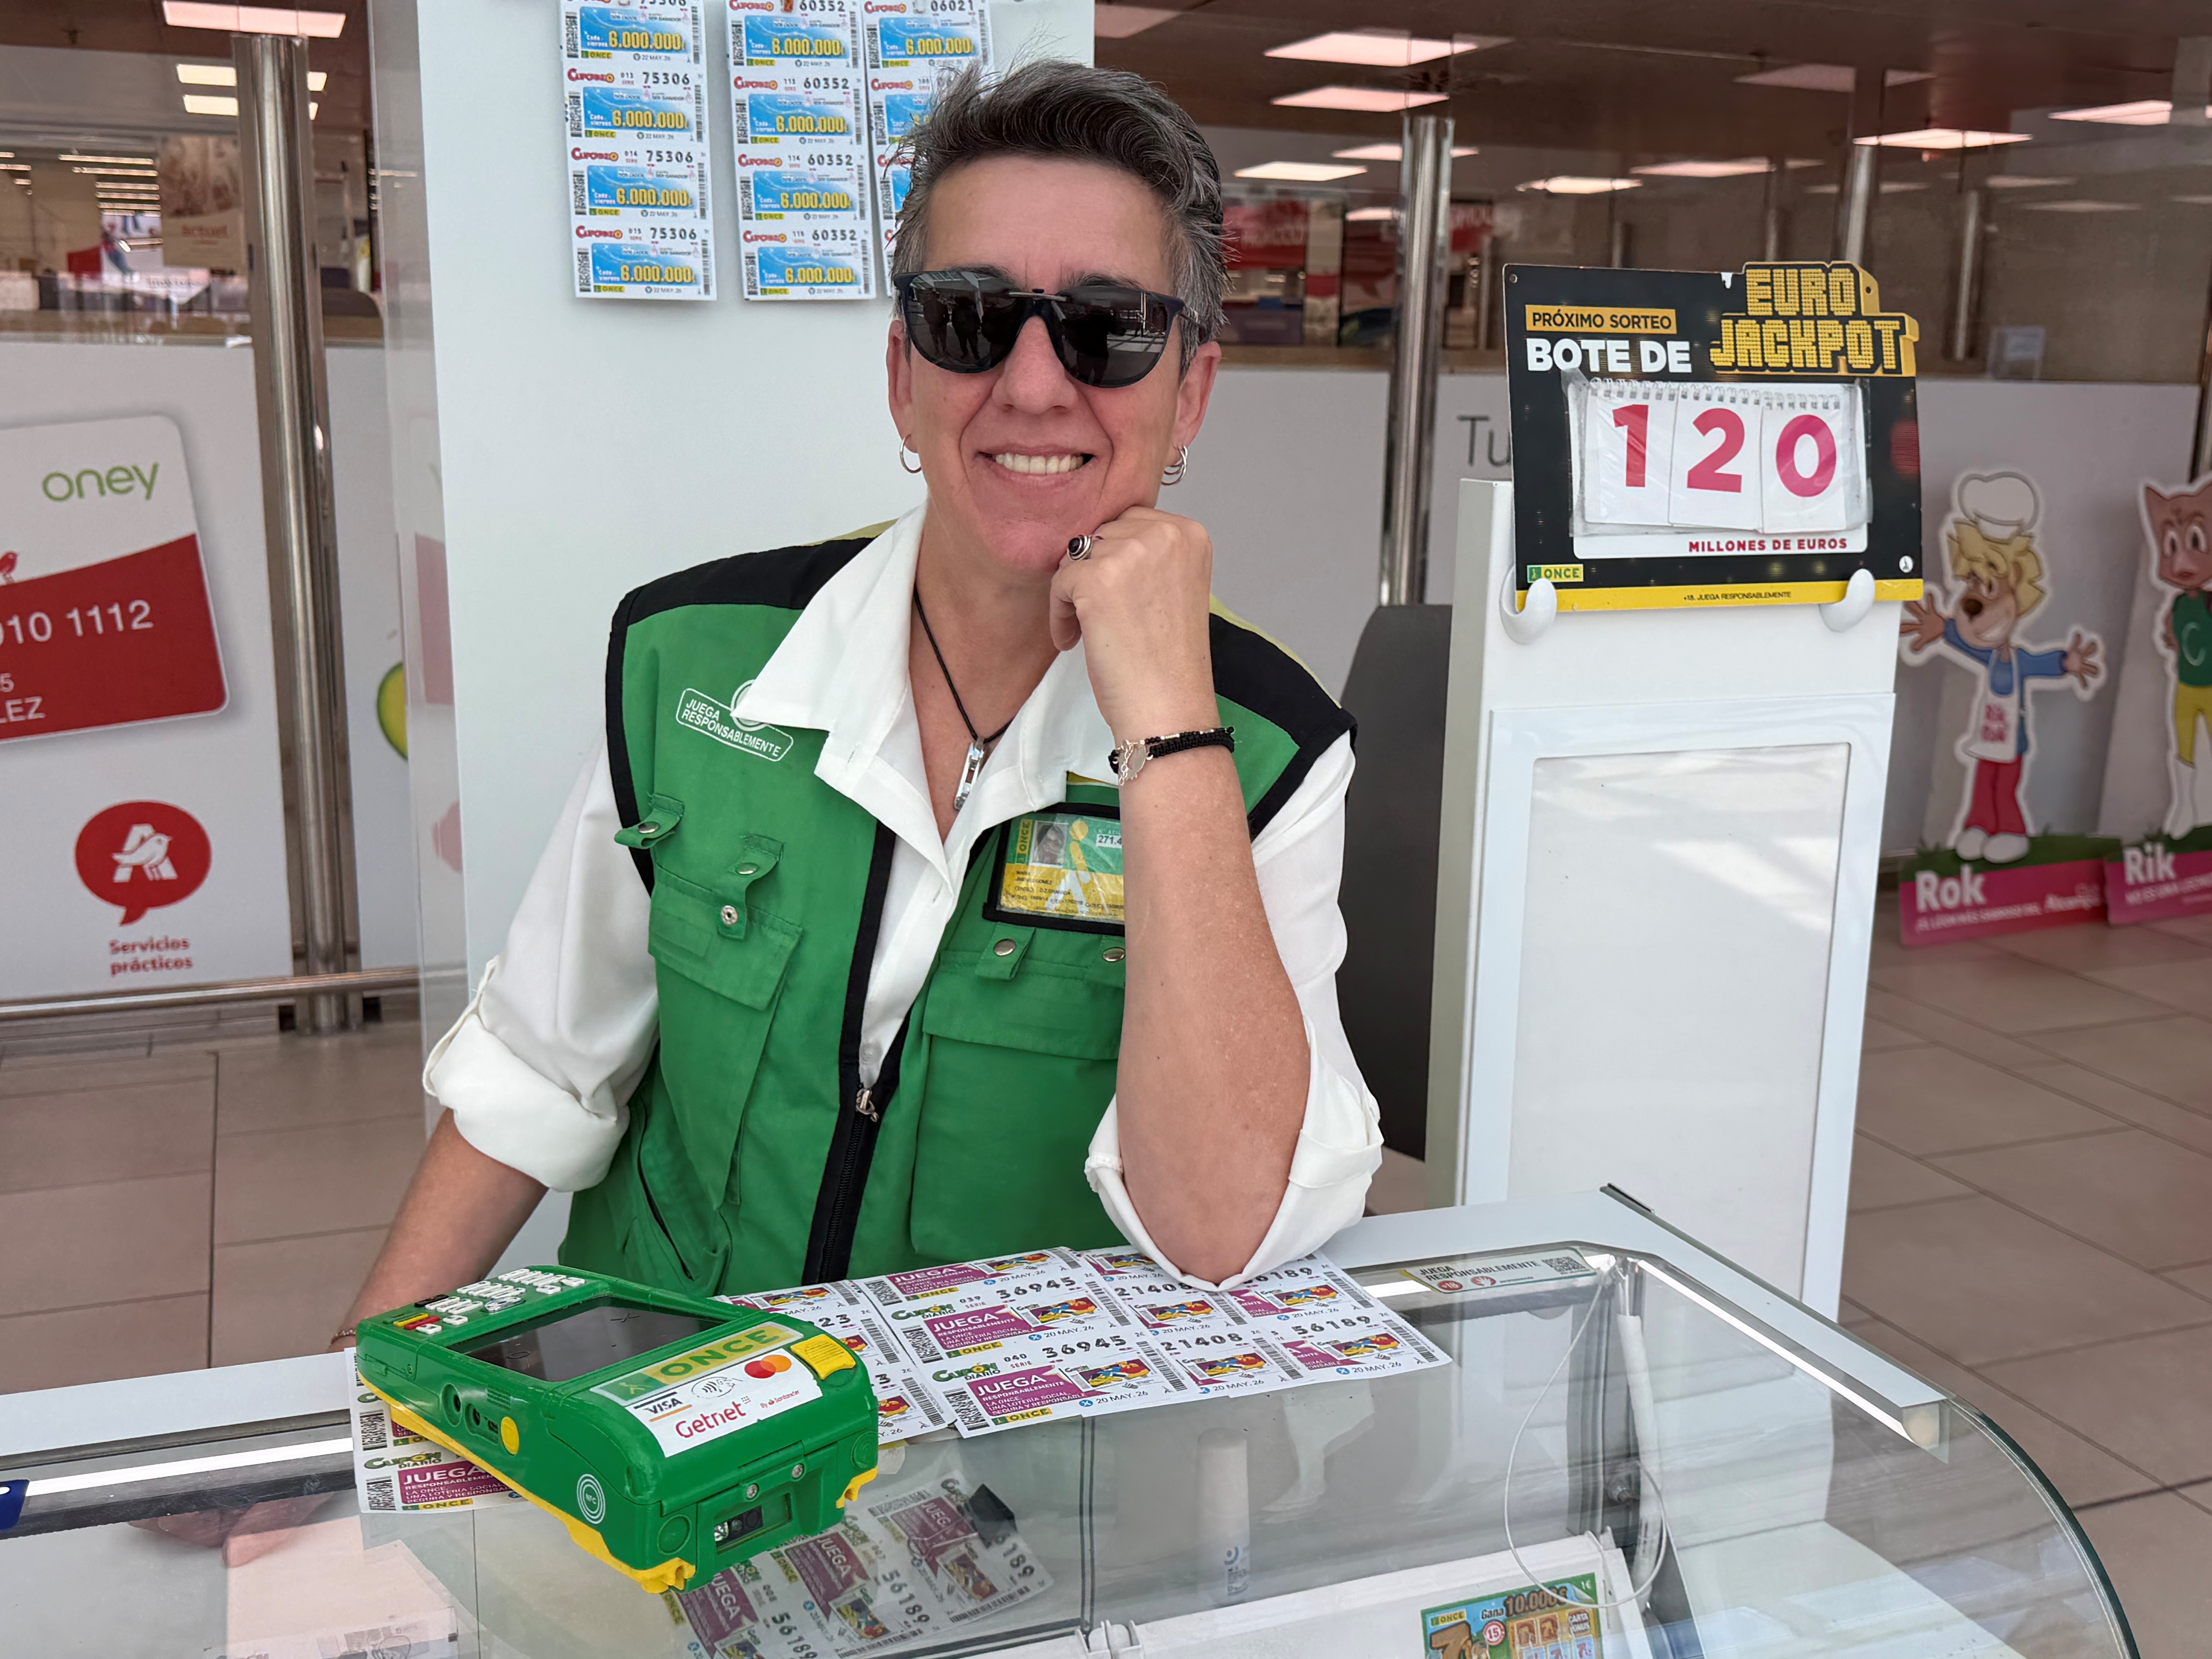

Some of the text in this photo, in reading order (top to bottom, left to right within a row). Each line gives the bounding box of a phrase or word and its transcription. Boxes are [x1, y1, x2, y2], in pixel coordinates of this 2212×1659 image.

[800, 1, 845, 12] 60352
[931, 0, 974, 11] 06021
[642, 72, 690, 84] 75306
[804, 78, 849, 89] 60352
[646, 150, 693, 163] 75306
[808, 155, 853, 166] 60352
[650, 228, 697, 240] 75306
[812, 230, 857, 240] 60352
[1747, 268, 1856, 316] EURO
[1532, 309, 1672, 330] PRÓXIMO SORTEO
[1710, 319, 1900, 370] JACKPOT
[1527, 337, 1692, 373] BOTE DE
[1456, 415, 1512, 467] Tu
[43, 462, 160, 501] oney
[1688, 538, 1847, 552] MILLONES DE EUROS
[1544, 568, 1580, 579] ONCE
[1721, 591, 1791, 600] RESPONSABLEMENTE
[0, 599, 154, 646] 10 1112
[686, 699, 720, 721] JUEGA
[682, 709, 781, 757] RESPONSABLEMENTE
[2123, 842, 2175, 885] Rik
[1915, 864, 1986, 913] Rok
[109, 936, 189, 955] Servicios
[110, 954, 193, 977] prácticos
[895, 1268, 957, 1283] JUEGA
[1243, 1267, 1312, 1284] 6189
[1420, 1266, 1455, 1276] JUEGA
[1426, 1261, 1541, 1281] RESPONSABLEMENTE
[921, 1287, 956, 1297] ONCE
[996, 1277, 1077, 1299] 36945
[922, 1309, 956, 1318] DIARIO
[933, 1313, 999, 1332] JUEGA
[938, 1318, 1016, 1336] RESPONSABLEMENTE
[1291, 1316, 1370, 1334] 56189
[964, 1342, 1001, 1353] ONCE
[1004, 1353, 1027, 1362] 040
[1042, 1335, 1126, 1358] 36945
[1161, 1333, 1243, 1352] 21408
[660, 1329, 780, 1376] ONCE
[965, 1369, 1001, 1381] DIARIO
[978, 1374, 1046, 1396] JUEGA
[982, 1381, 1064, 1401] RESPONSABLEMENTE
[775, 1390, 800, 1404] Santander
[644, 1398, 683, 1414] VISA
[1009, 1408, 1051, 1421] ONCE
[675, 1401, 747, 1438] Getnet
[398, 1459, 441, 1468] DIARIO
[404, 1466, 484, 1485] JUEGA
[405, 1475, 493, 1490] RESPONSABLEMEN
[422, 1499, 470, 1509] ONCE
[585, 1493, 597, 1505] NFC
[817, 1537, 851, 1577] JUEGA
[882, 1570, 929, 1623] 56189
[1440, 1611, 1464, 1623] ONCE
[1481, 1608, 1504, 1620] Gana
[1487, 1627, 1501, 1640] 15
